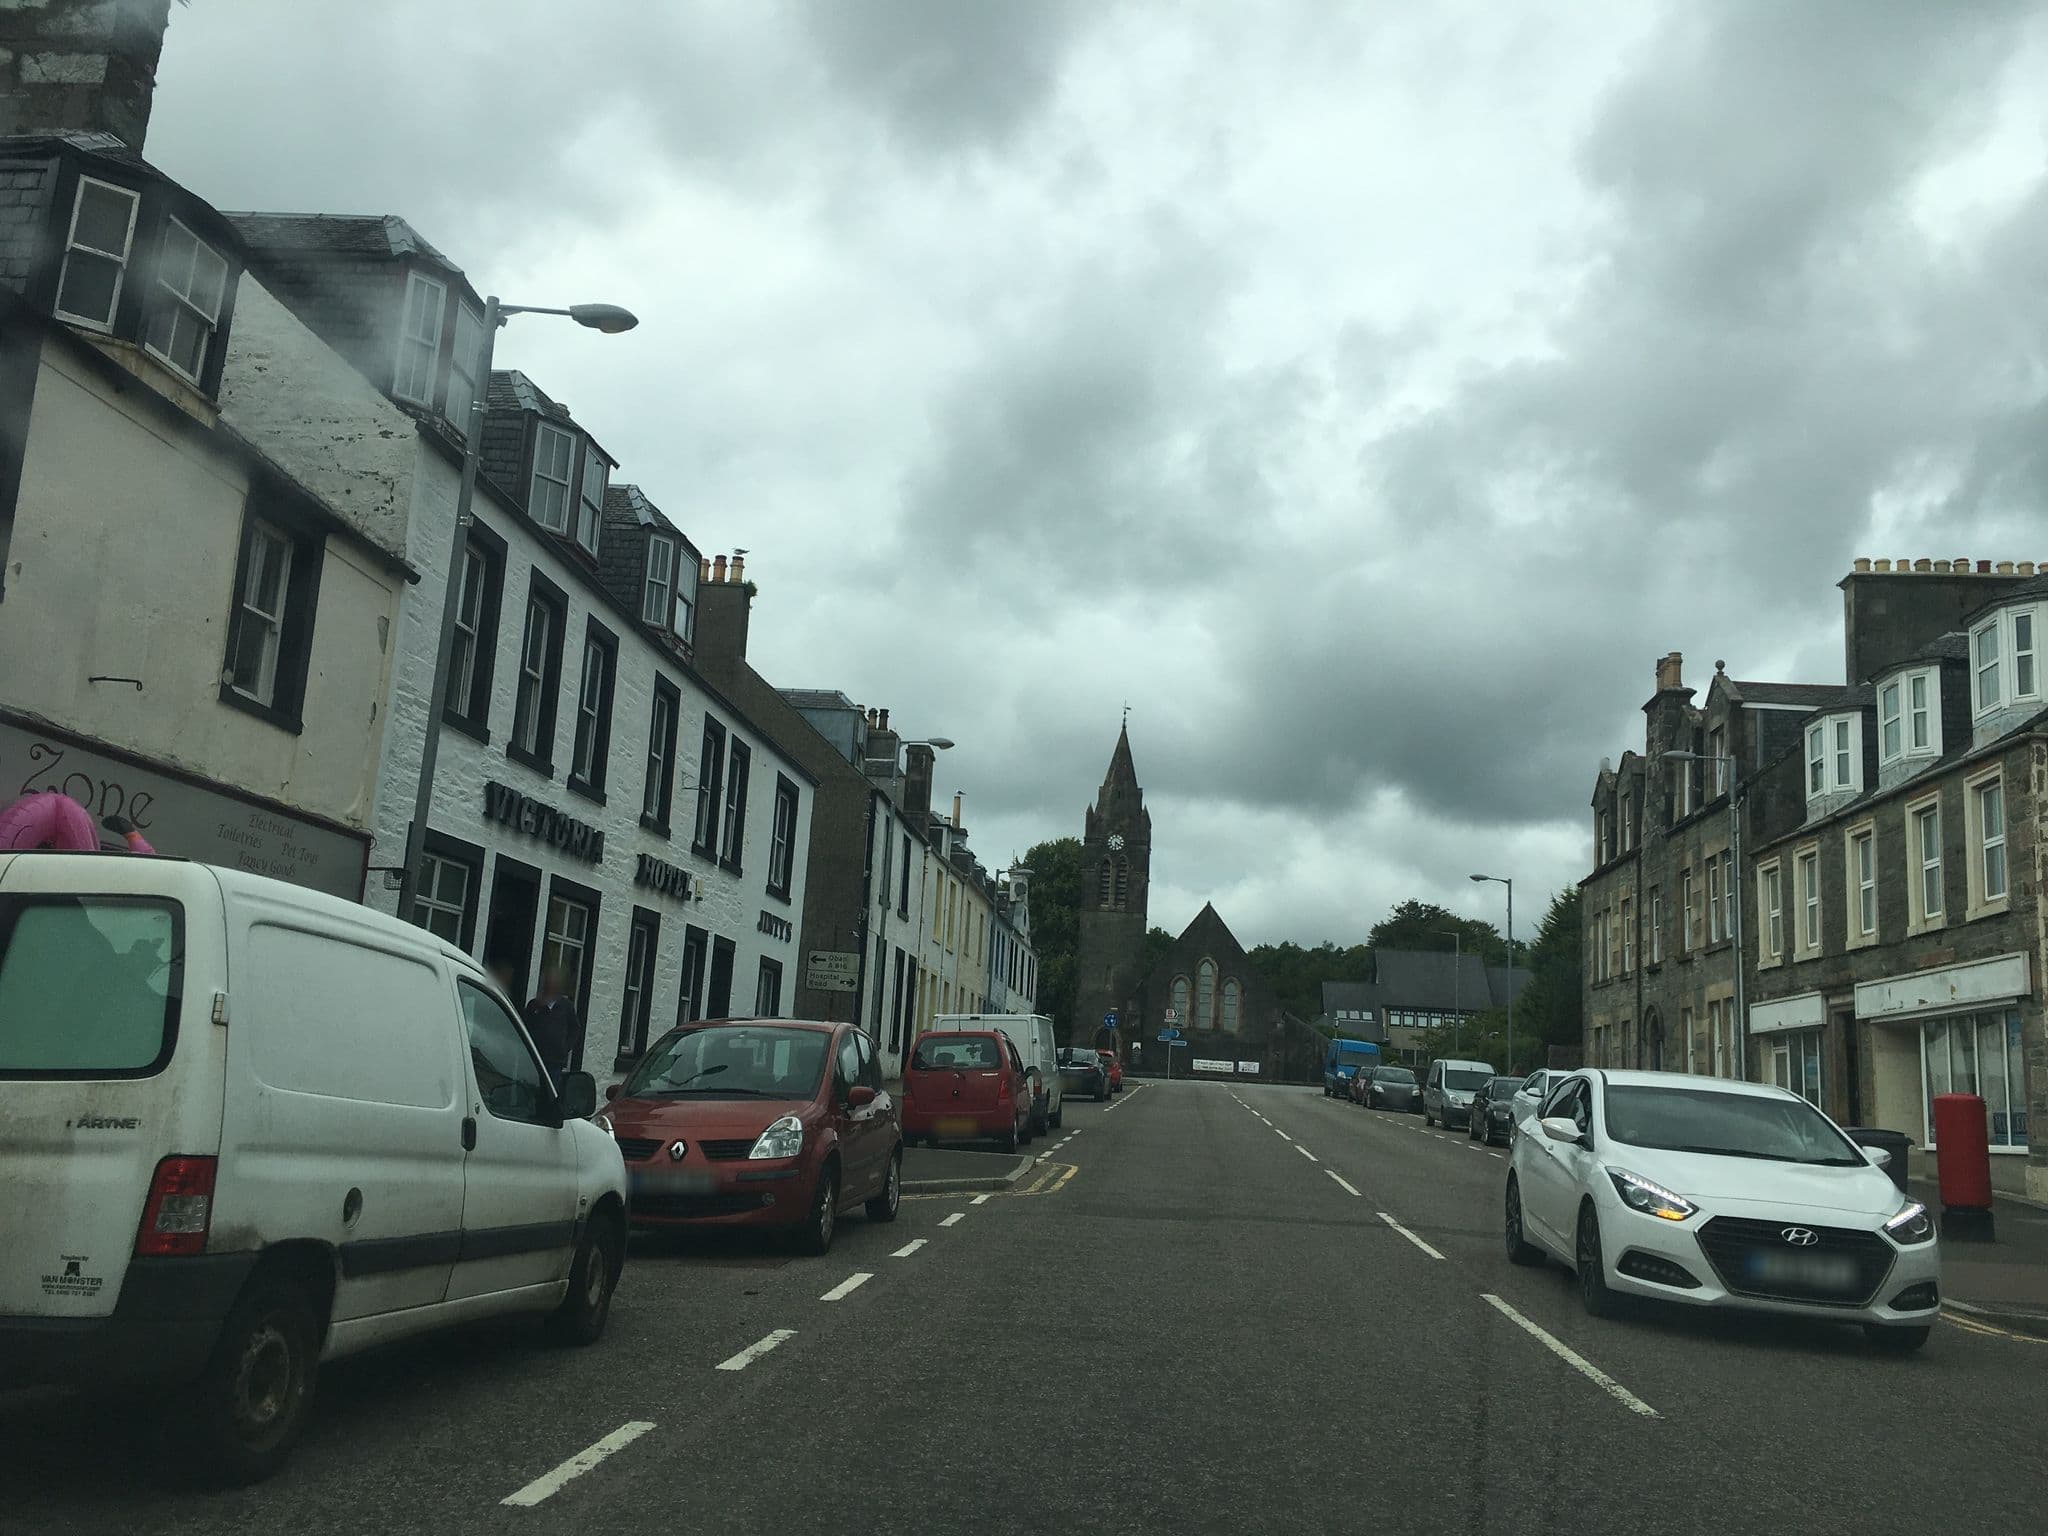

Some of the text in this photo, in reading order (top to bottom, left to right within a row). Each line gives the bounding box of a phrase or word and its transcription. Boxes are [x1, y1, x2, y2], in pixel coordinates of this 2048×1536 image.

[20, 743, 155, 829] Zone
[248, 814, 295, 839] Electrical
[483, 780, 605, 864] VICTORIA
[216, 823, 264, 849] Toiletries
[238, 850, 297, 877] Fancy Goods
[281, 842, 320, 865] Pet Toys
[634, 853, 692, 901] HOTEL
[809, 972, 840, 980] Hospital
[41, 1274, 103, 1287] VAN MONSTER
